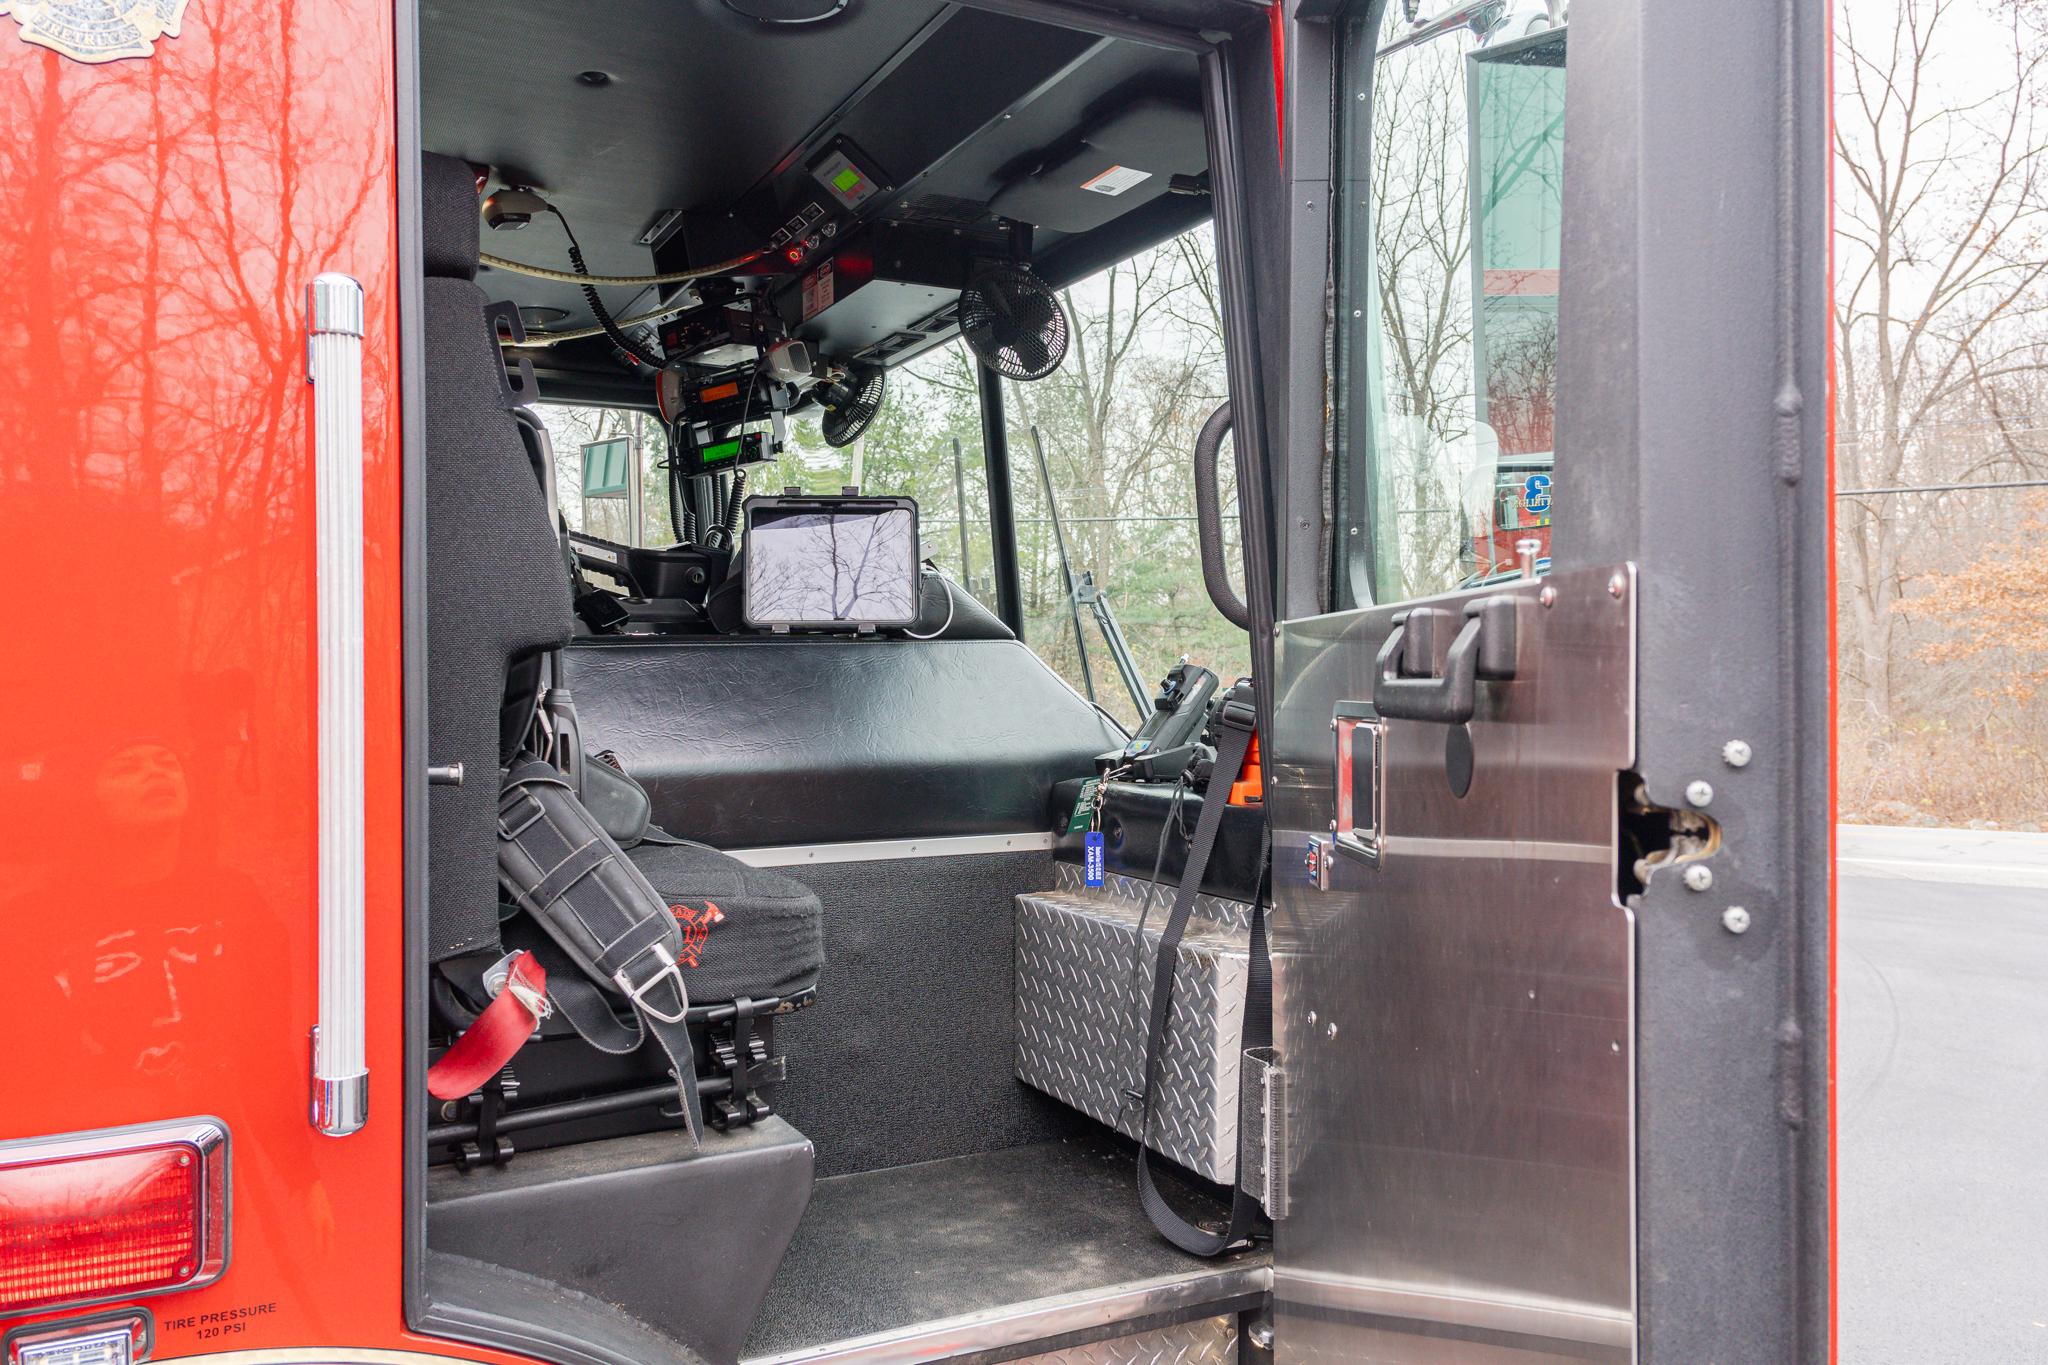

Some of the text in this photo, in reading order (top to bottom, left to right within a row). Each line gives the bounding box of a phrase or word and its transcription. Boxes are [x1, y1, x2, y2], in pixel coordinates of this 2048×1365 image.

[34, 15, 140, 45] FIRETRUCKS
[164, 1302, 277, 1332] TIRE PRESSURE
[196, 1322, 247, 1340] 120 PSI
